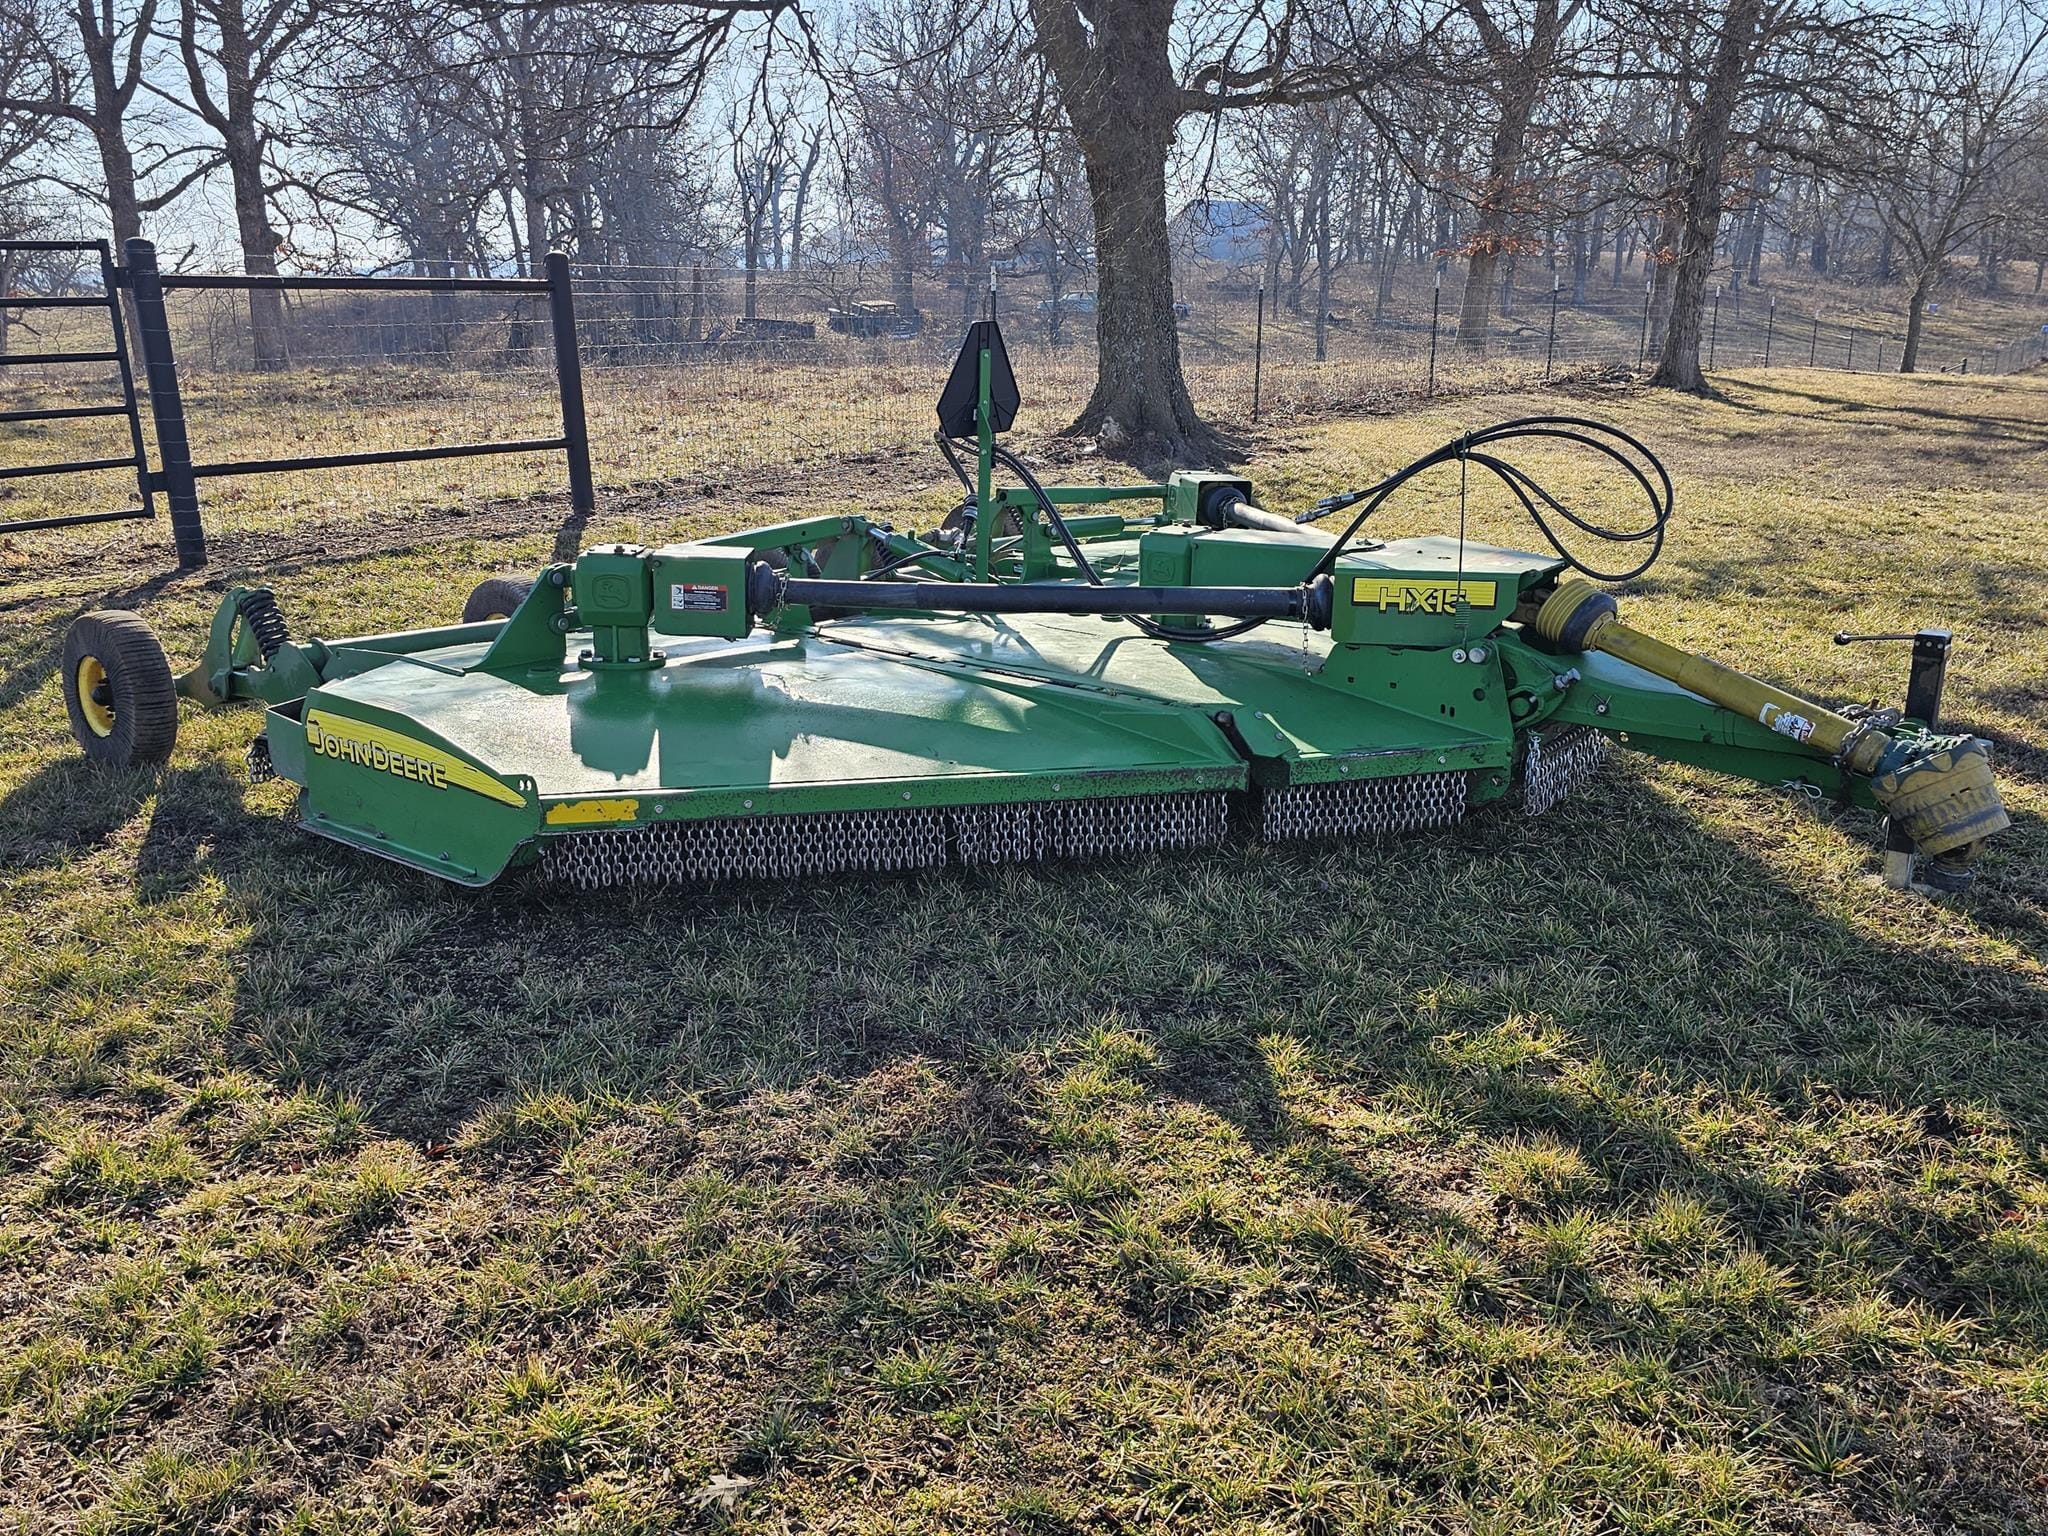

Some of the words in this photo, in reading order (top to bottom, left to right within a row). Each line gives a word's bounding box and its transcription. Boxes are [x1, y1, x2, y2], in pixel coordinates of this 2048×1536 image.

[1379, 587, 1467, 614] HX15
[314, 727, 371, 767] JOHN
[370, 740, 448, 789] DEERE
